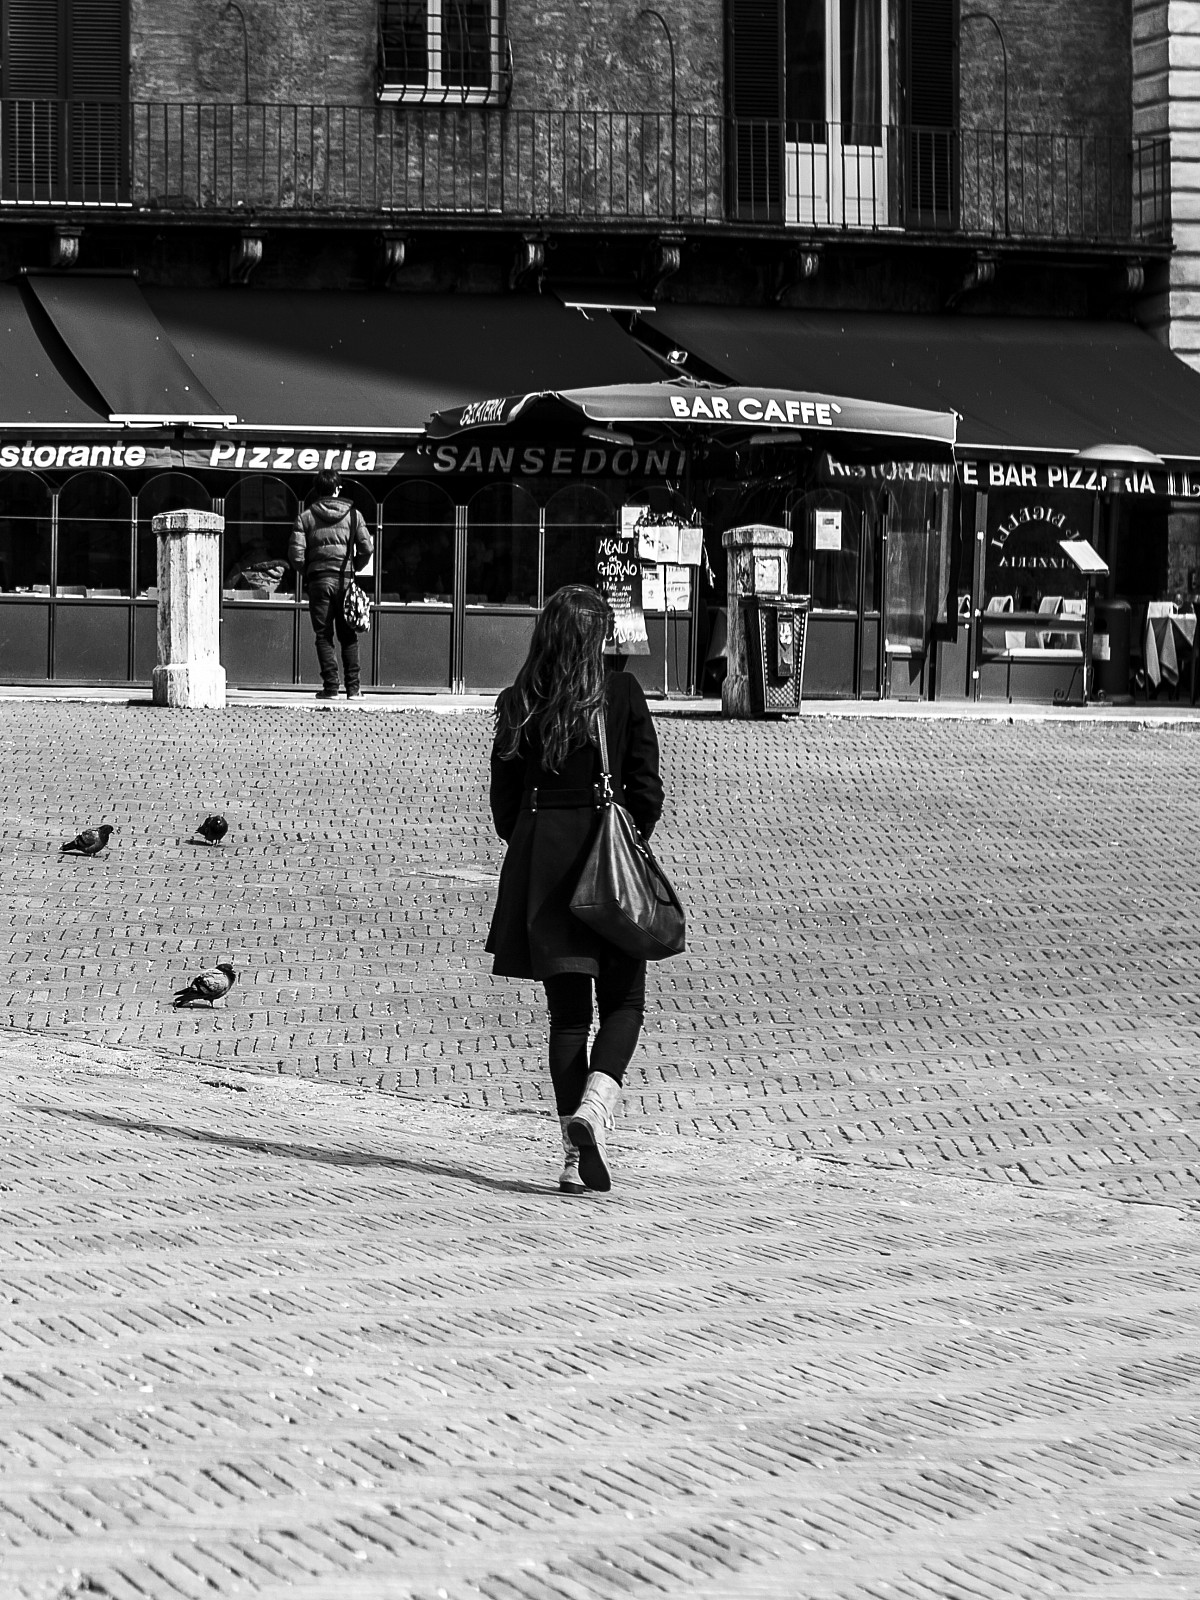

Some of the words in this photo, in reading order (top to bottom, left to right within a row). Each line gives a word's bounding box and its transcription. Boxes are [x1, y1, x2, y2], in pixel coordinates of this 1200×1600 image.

[670, 396, 732, 420] BAR
[209, 440, 378, 471] Pizzeria
[989, 461, 1037, 487] BAR
